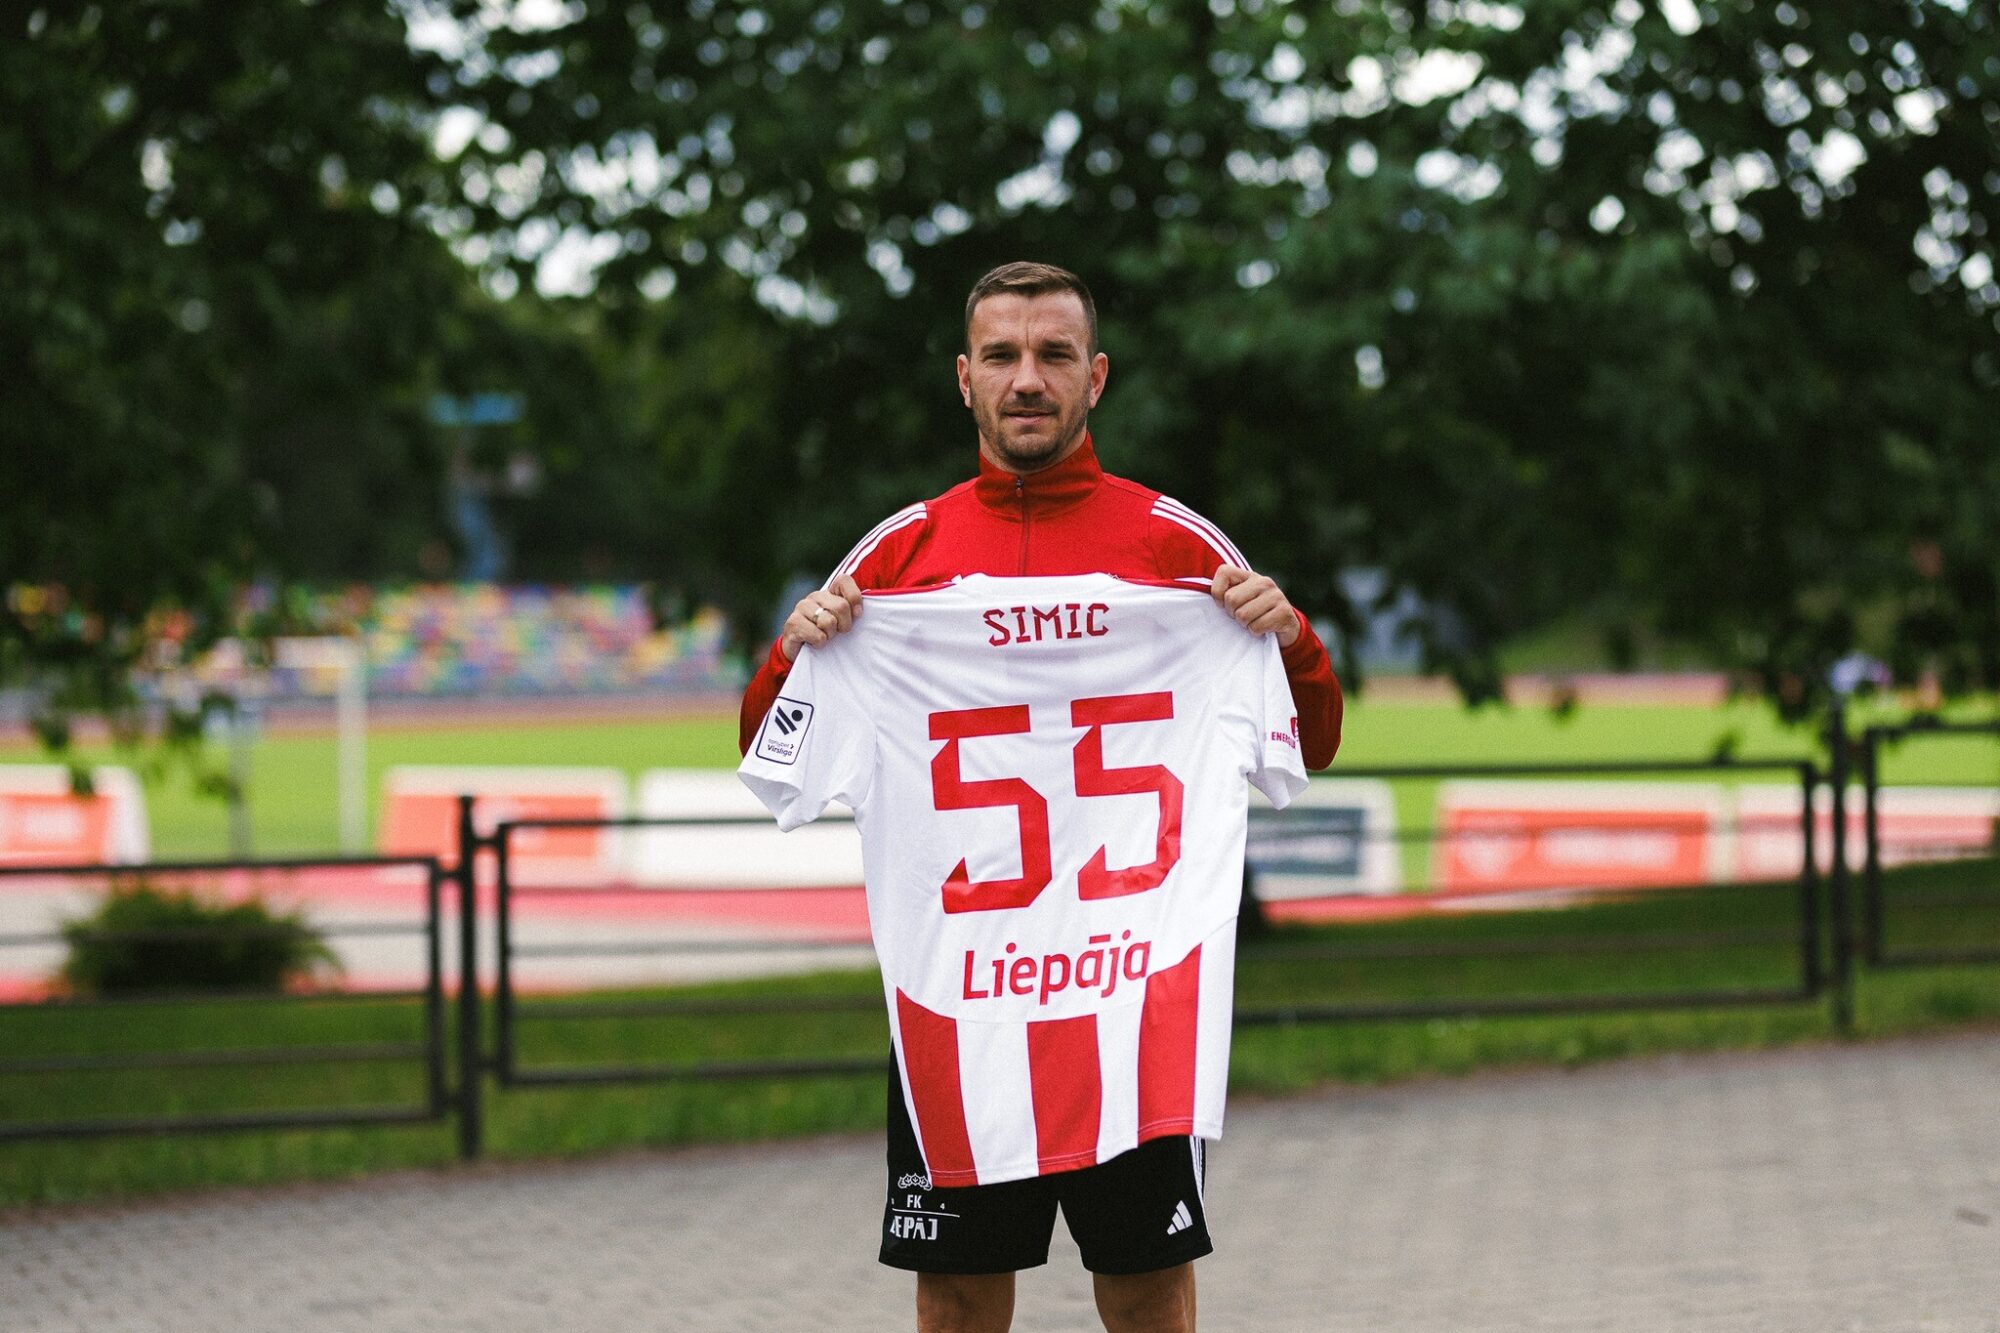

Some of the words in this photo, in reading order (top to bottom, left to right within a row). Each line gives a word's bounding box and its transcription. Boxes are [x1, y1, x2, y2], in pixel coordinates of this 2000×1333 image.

[982, 602, 1110, 647] SIMIC
[928, 691, 1184, 914] 55
[962, 929, 1152, 1006] Liepāja
[906, 1194, 922, 1209] FK
